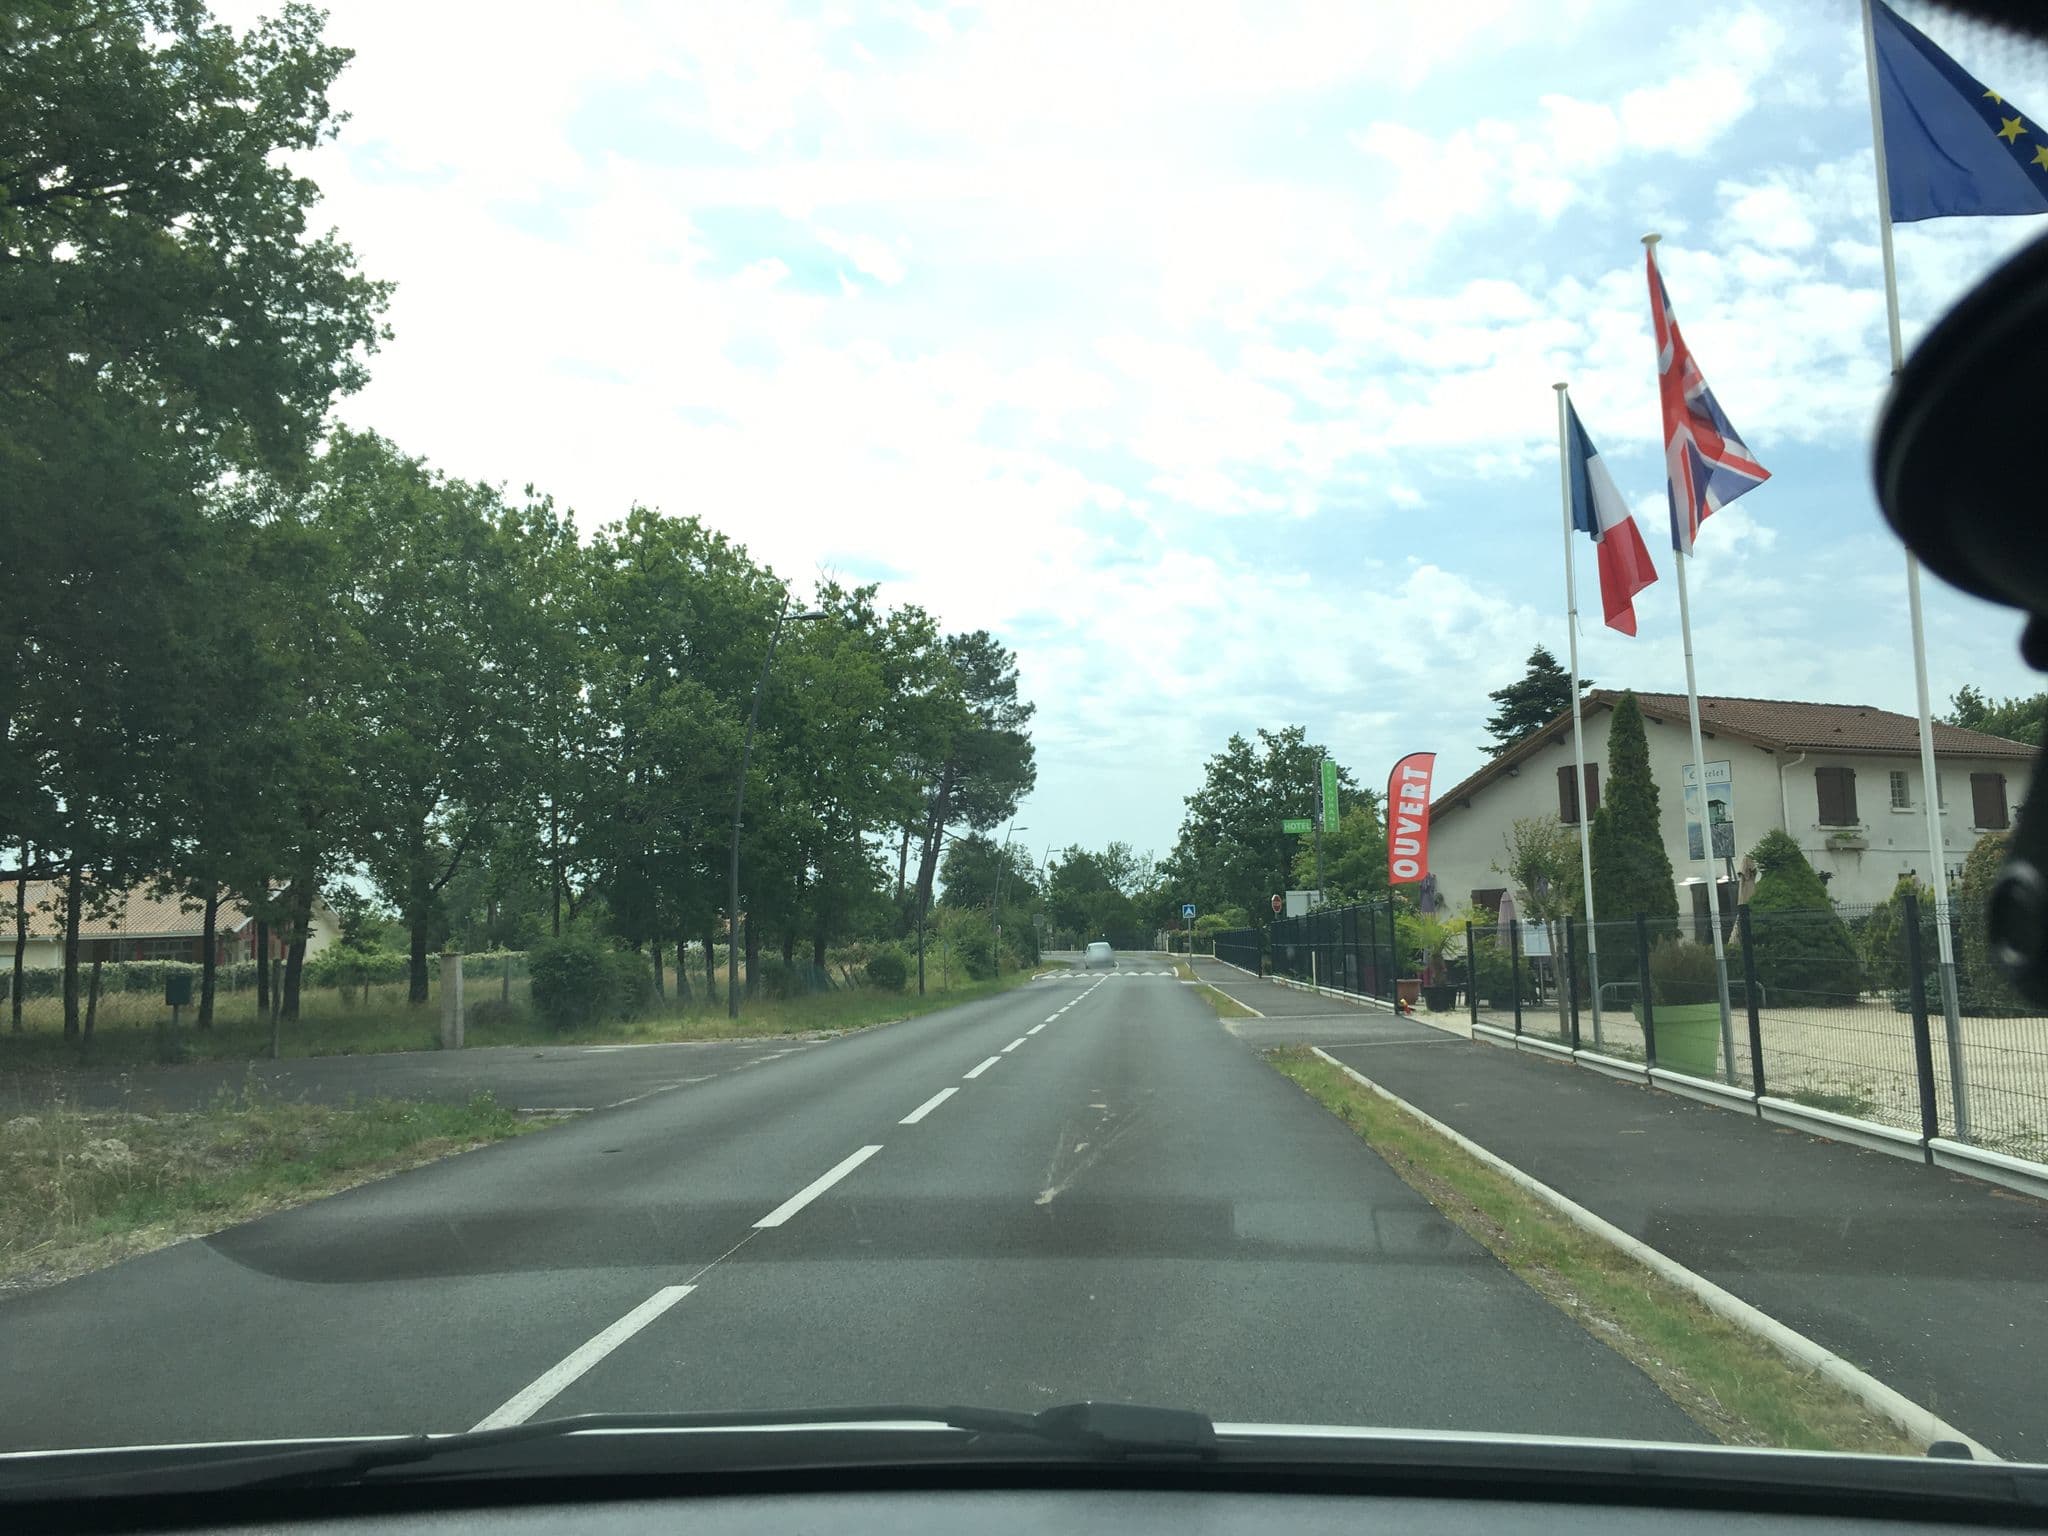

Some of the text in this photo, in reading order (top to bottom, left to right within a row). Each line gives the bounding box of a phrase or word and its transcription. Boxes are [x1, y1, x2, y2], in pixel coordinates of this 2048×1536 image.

[1284, 822, 1311, 831] HOTEL
[1326, 761, 1335, 828] RESTAURANT
[1393, 766, 1428, 878] OUVERT
